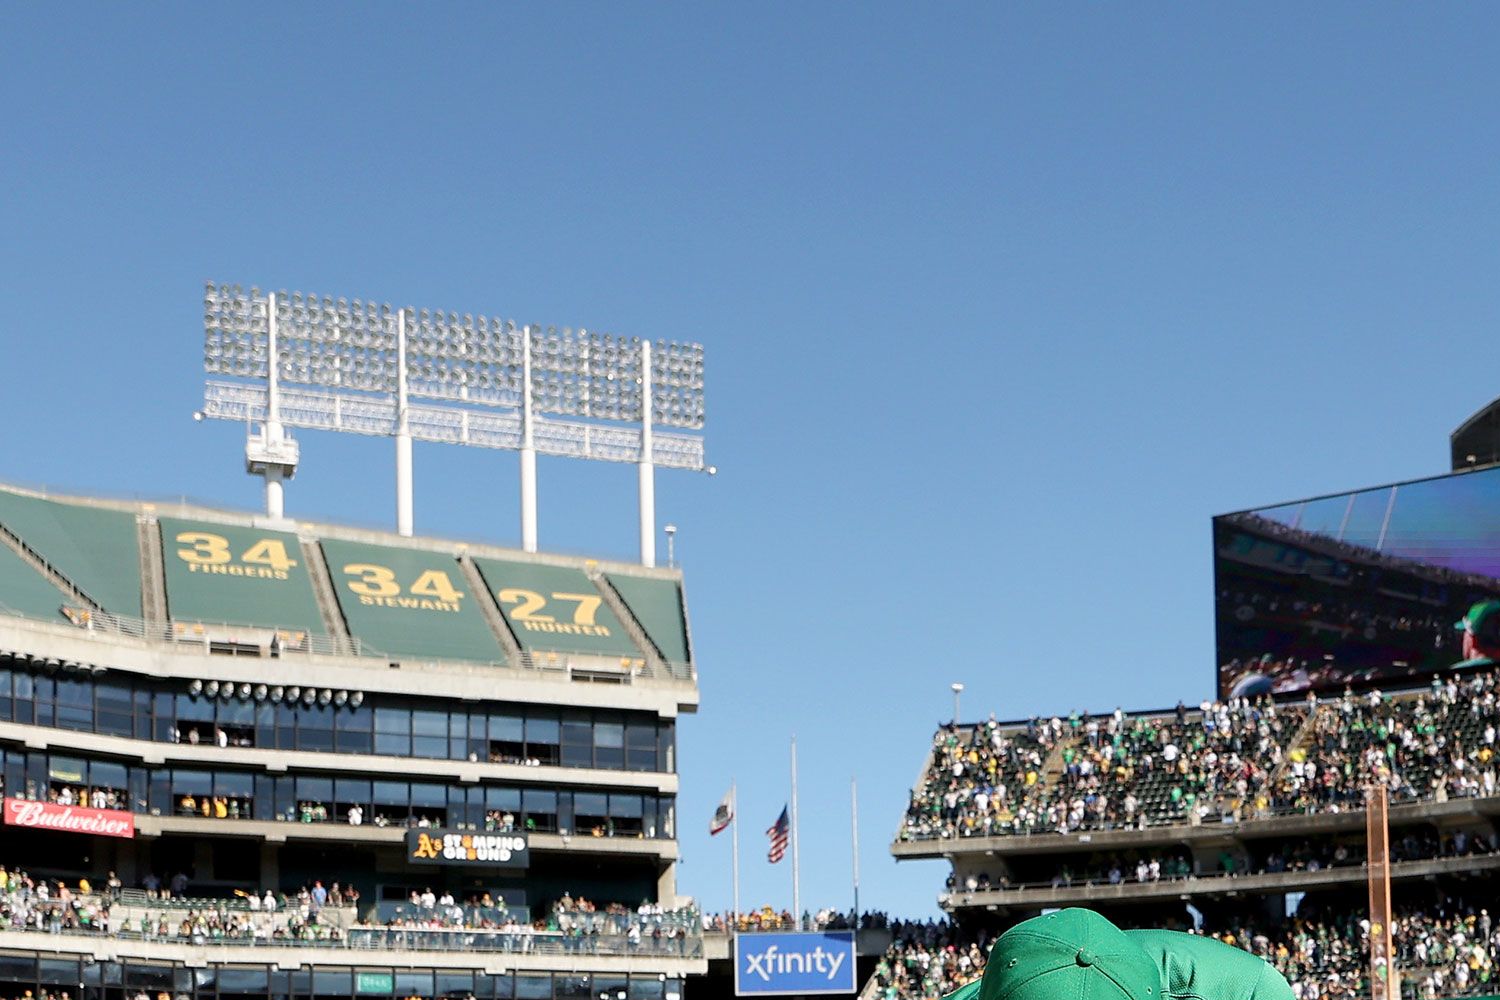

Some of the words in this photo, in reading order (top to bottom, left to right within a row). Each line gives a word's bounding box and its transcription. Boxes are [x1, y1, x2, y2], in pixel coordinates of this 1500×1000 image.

[177, 532, 297, 572] 34
[188, 563, 289, 581] FINGERS
[343, 563, 465, 602] 34
[359, 595, 461, 613] STEWART
[499, 588, 602, 626] 27
[523, 620, 611, 638] HUNTER
[11, 800, 129, 834] Budweiser
[745, 944, 845, 982] xfinity
